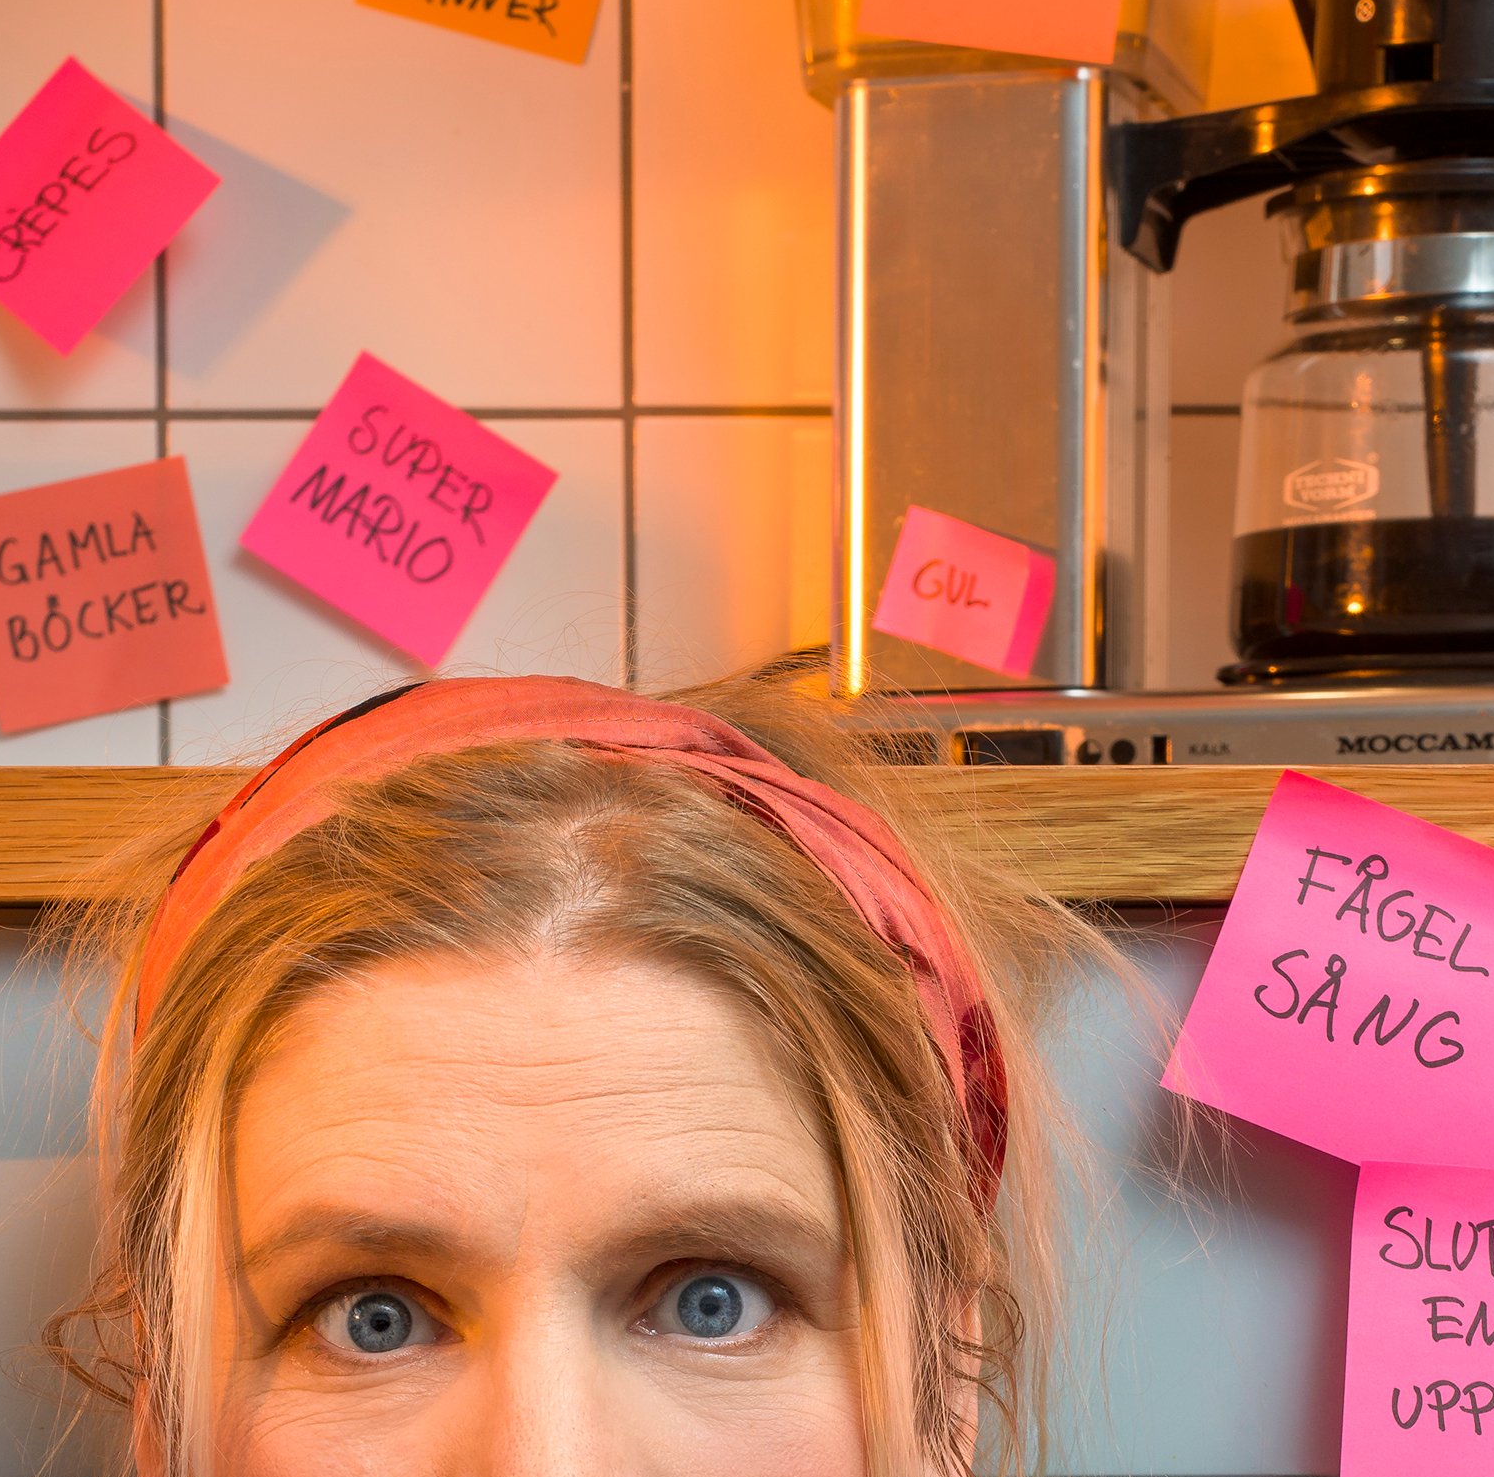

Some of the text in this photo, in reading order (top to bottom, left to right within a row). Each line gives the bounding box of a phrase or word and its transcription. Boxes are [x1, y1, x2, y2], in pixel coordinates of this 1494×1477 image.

[291, 465, 453, 583] MARIO
[347, 405, 494, 545] SUPER
[8, 578, 204, 663] BÖCKER
[913, 561, 989, 608] GUL
[1253, 948, 1466, 1069] SÅNG
